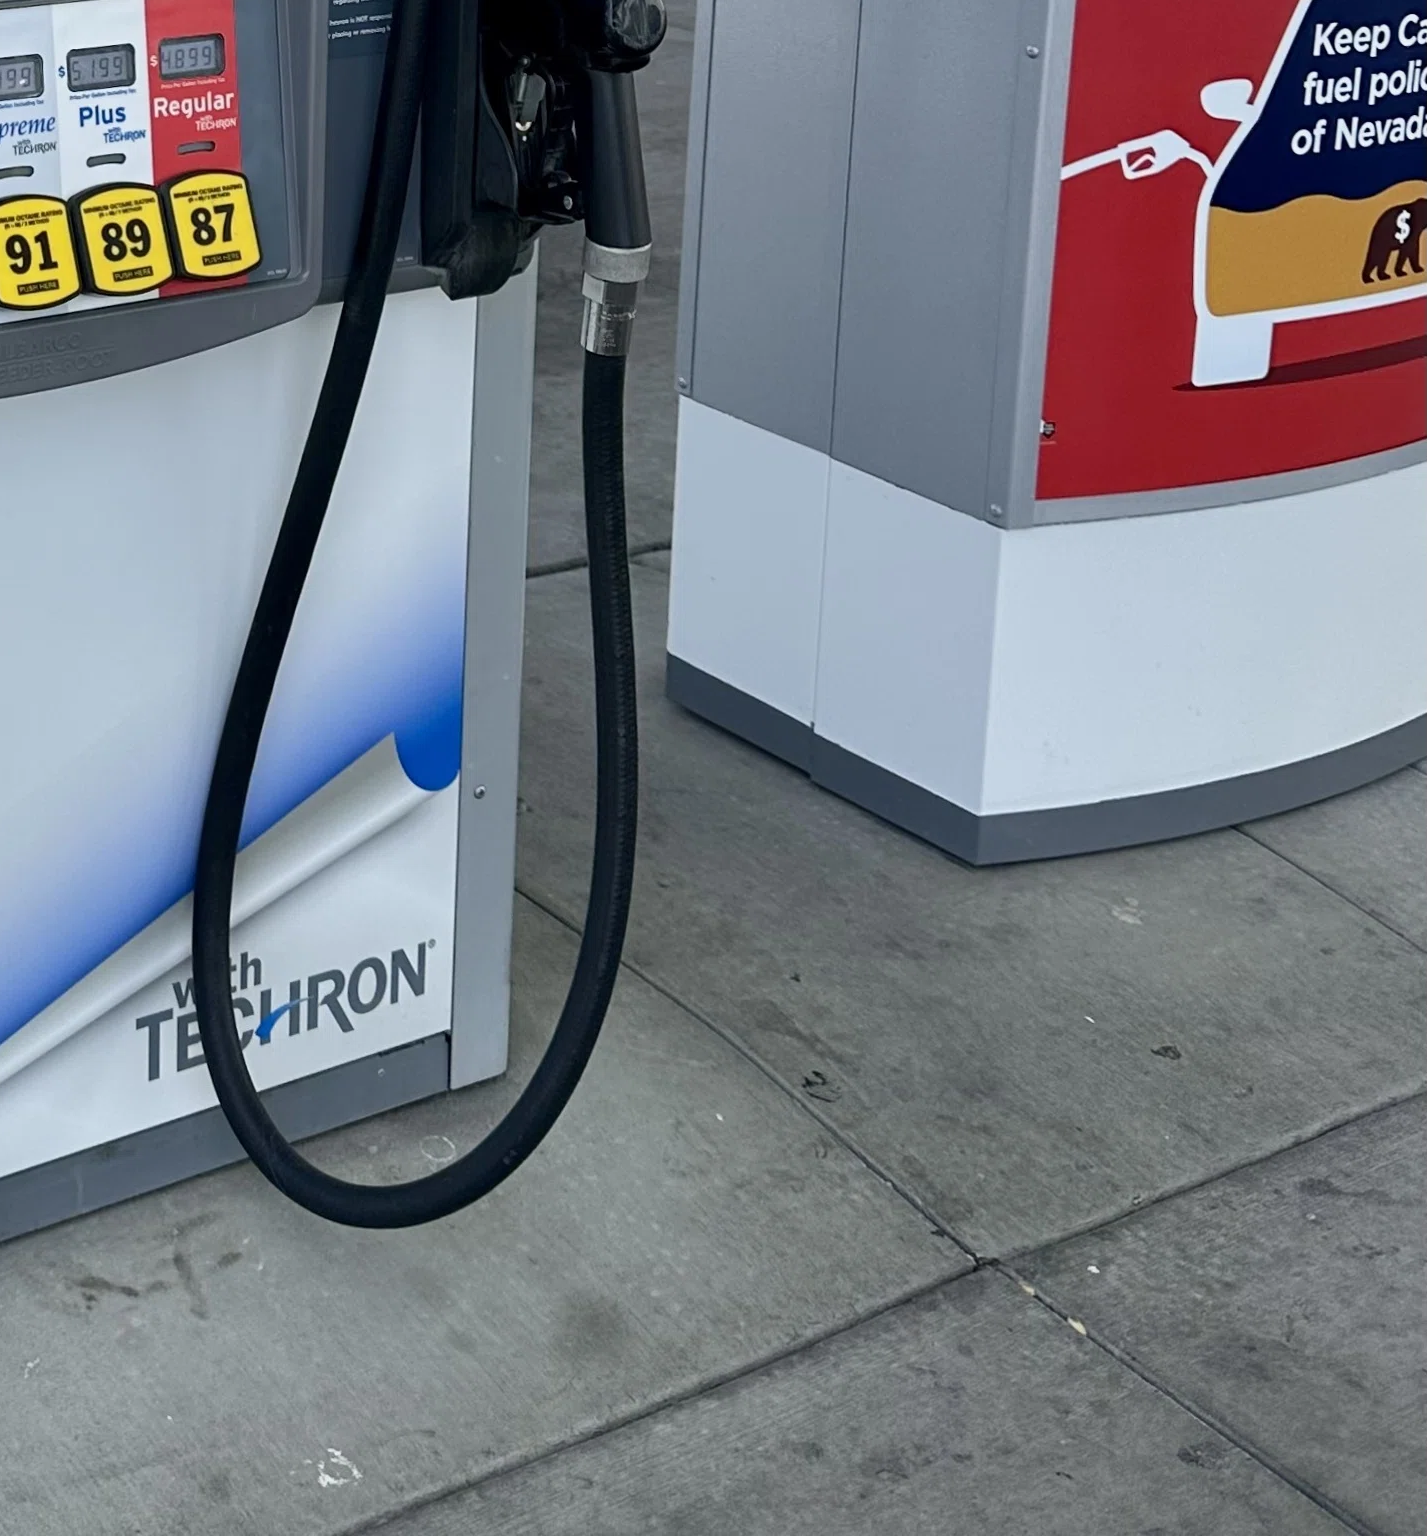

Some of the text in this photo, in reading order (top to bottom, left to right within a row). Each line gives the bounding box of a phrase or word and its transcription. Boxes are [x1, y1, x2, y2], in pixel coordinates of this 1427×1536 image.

[1313, 21, 1391, 58] Keep
[1303, 66, 1362, 106] fuel
[79, 106, 126, 127] Plus
[154, 91, 234, 120] Regular
[104, 129, 146, 144] TECHRON
[195, 117, 237, 131] TECHRON
[1291, 120, 1326, 155] of
[13, 140, 57, 156] TECHRON
[101, 218, 151, 262] 89
[190, 203, 235, 247] 87
[5, 230, 58, 275] 91
